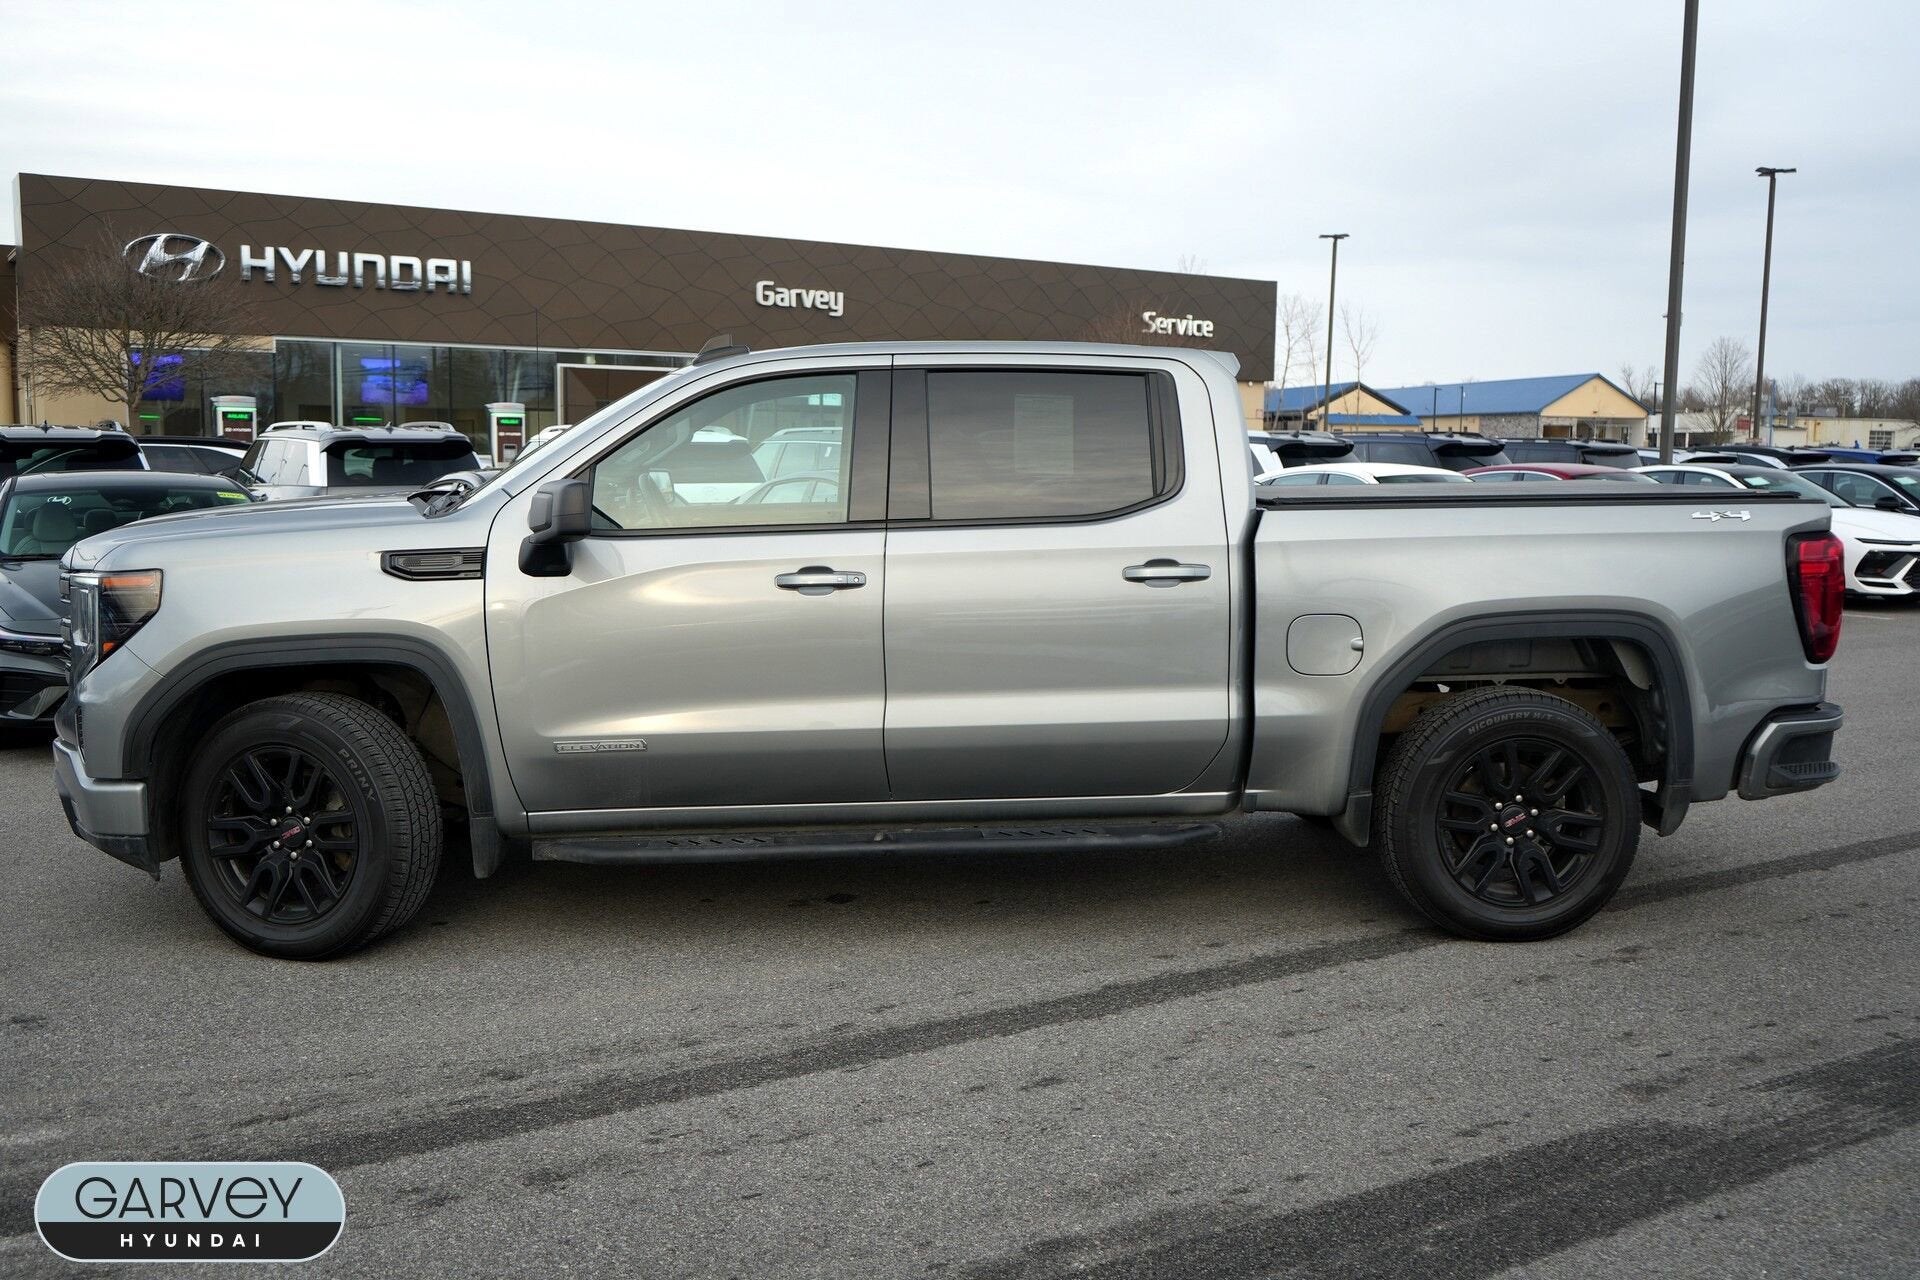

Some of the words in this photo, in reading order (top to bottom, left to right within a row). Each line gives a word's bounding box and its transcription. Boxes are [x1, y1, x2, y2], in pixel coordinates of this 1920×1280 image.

[240, 244, 472, 294] HYUNDAI
[755, 280, 844, 317] Garvey
[1141, 311, 1214, 338] Service
[560, 741, 640, 752] ELEVATION
[337, 748, 377, 802] PRINX
